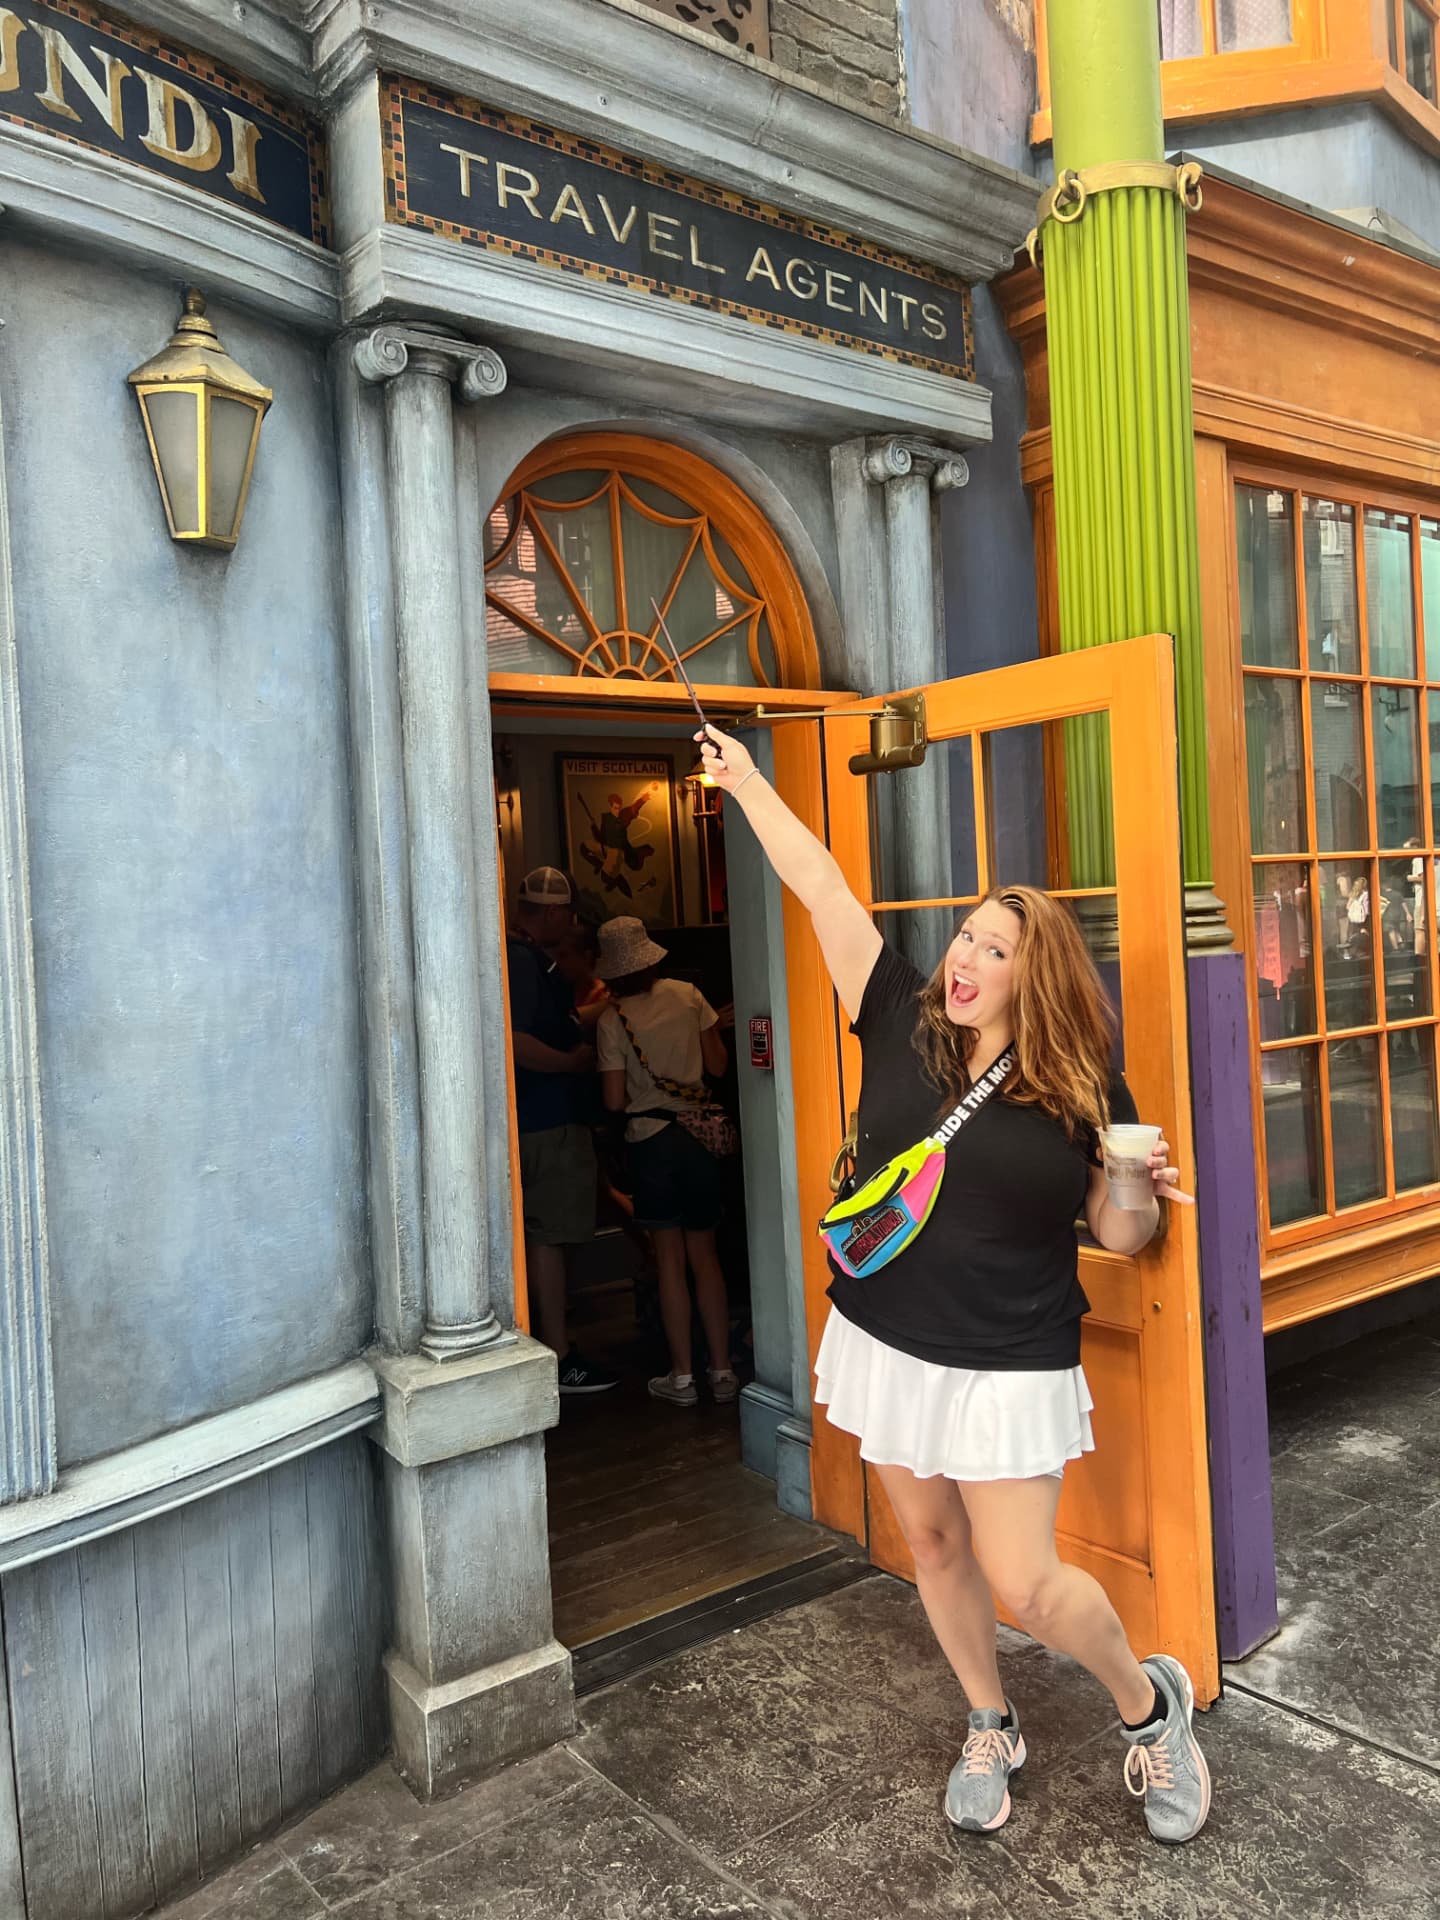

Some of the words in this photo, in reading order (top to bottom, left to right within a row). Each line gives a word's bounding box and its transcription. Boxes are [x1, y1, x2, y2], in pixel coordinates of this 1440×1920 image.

[440, 142, 726, 274] TRAVEL
[745, 246, 948, 342] AGENTS
[566, 760, 598, 772] VISIT
[602, 761, 665, 774] SCOTLAND
[750, 1021, 768, 1032] FIRE
[933, 1105, 971, 1147] RIDE
[962, 1078, 995, 1109] THE
